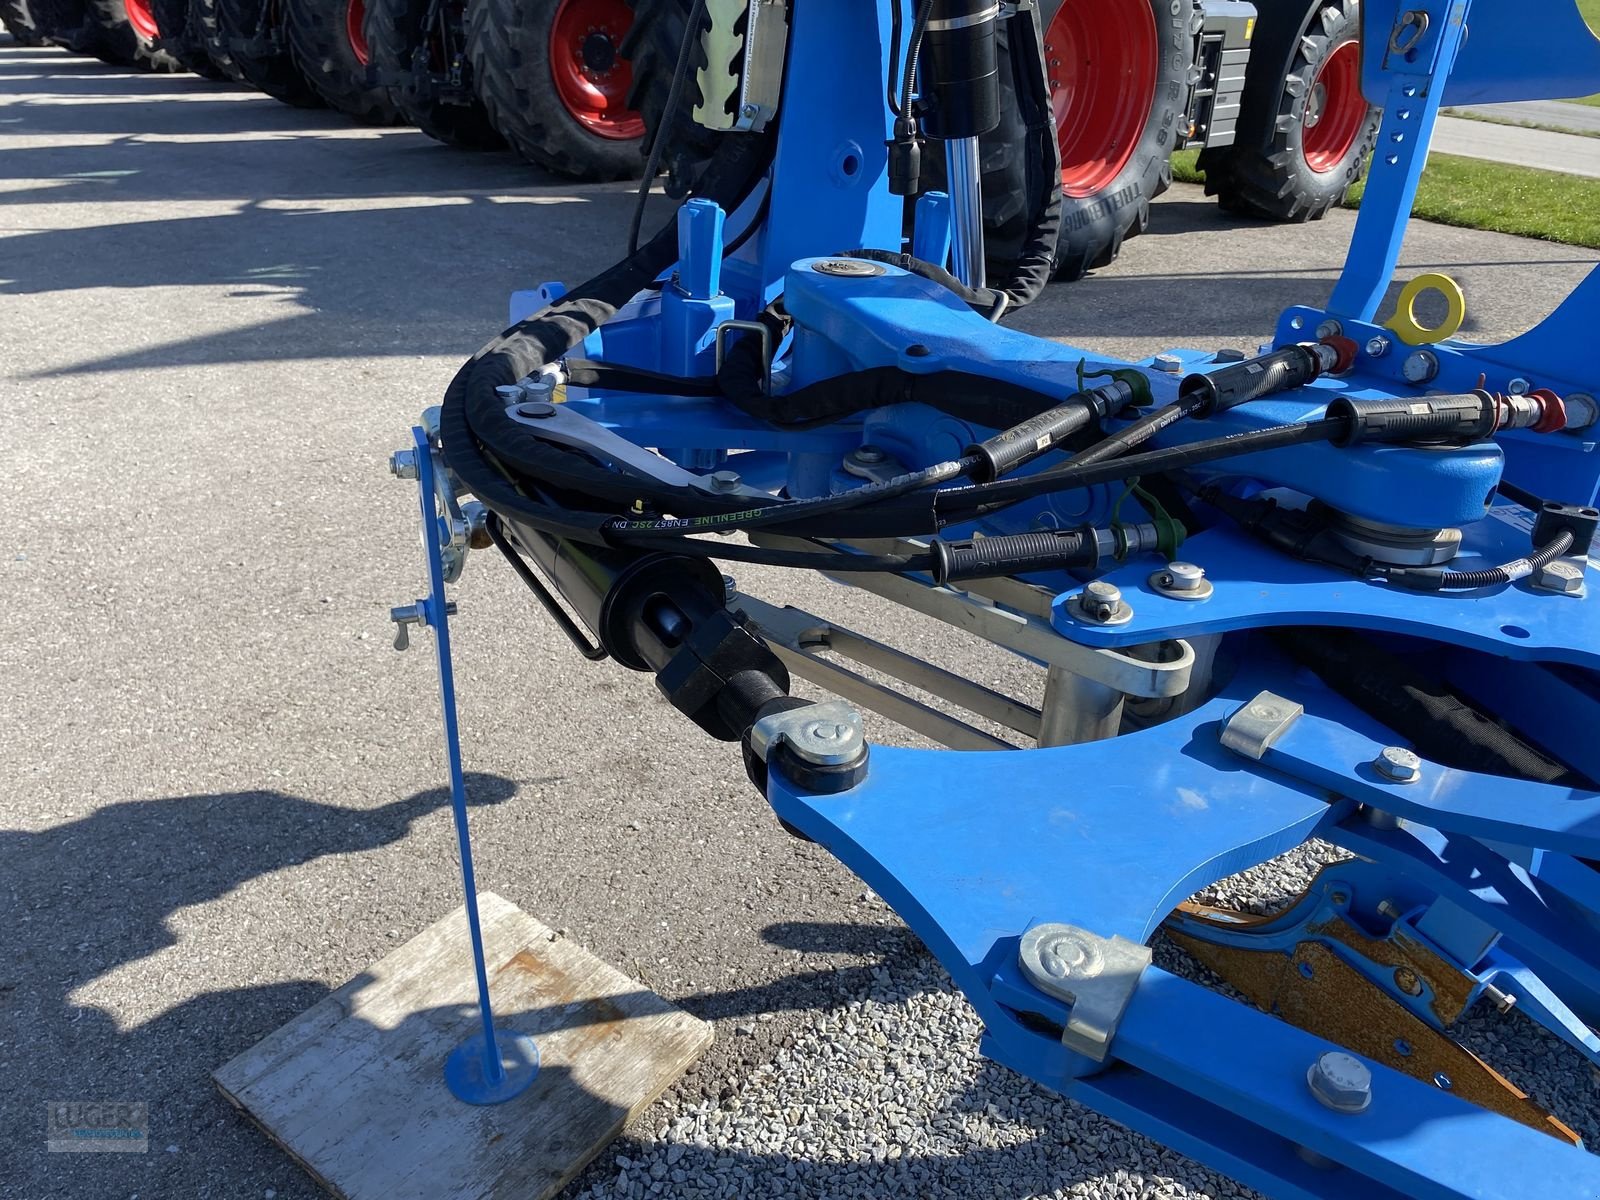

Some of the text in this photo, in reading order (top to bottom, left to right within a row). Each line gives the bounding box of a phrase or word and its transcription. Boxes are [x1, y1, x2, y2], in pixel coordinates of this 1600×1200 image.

[1064, 182, 1142, 233] TRELLEBORG
[612, 509, 762, 529] GREENLINE EN857 2SC DN
